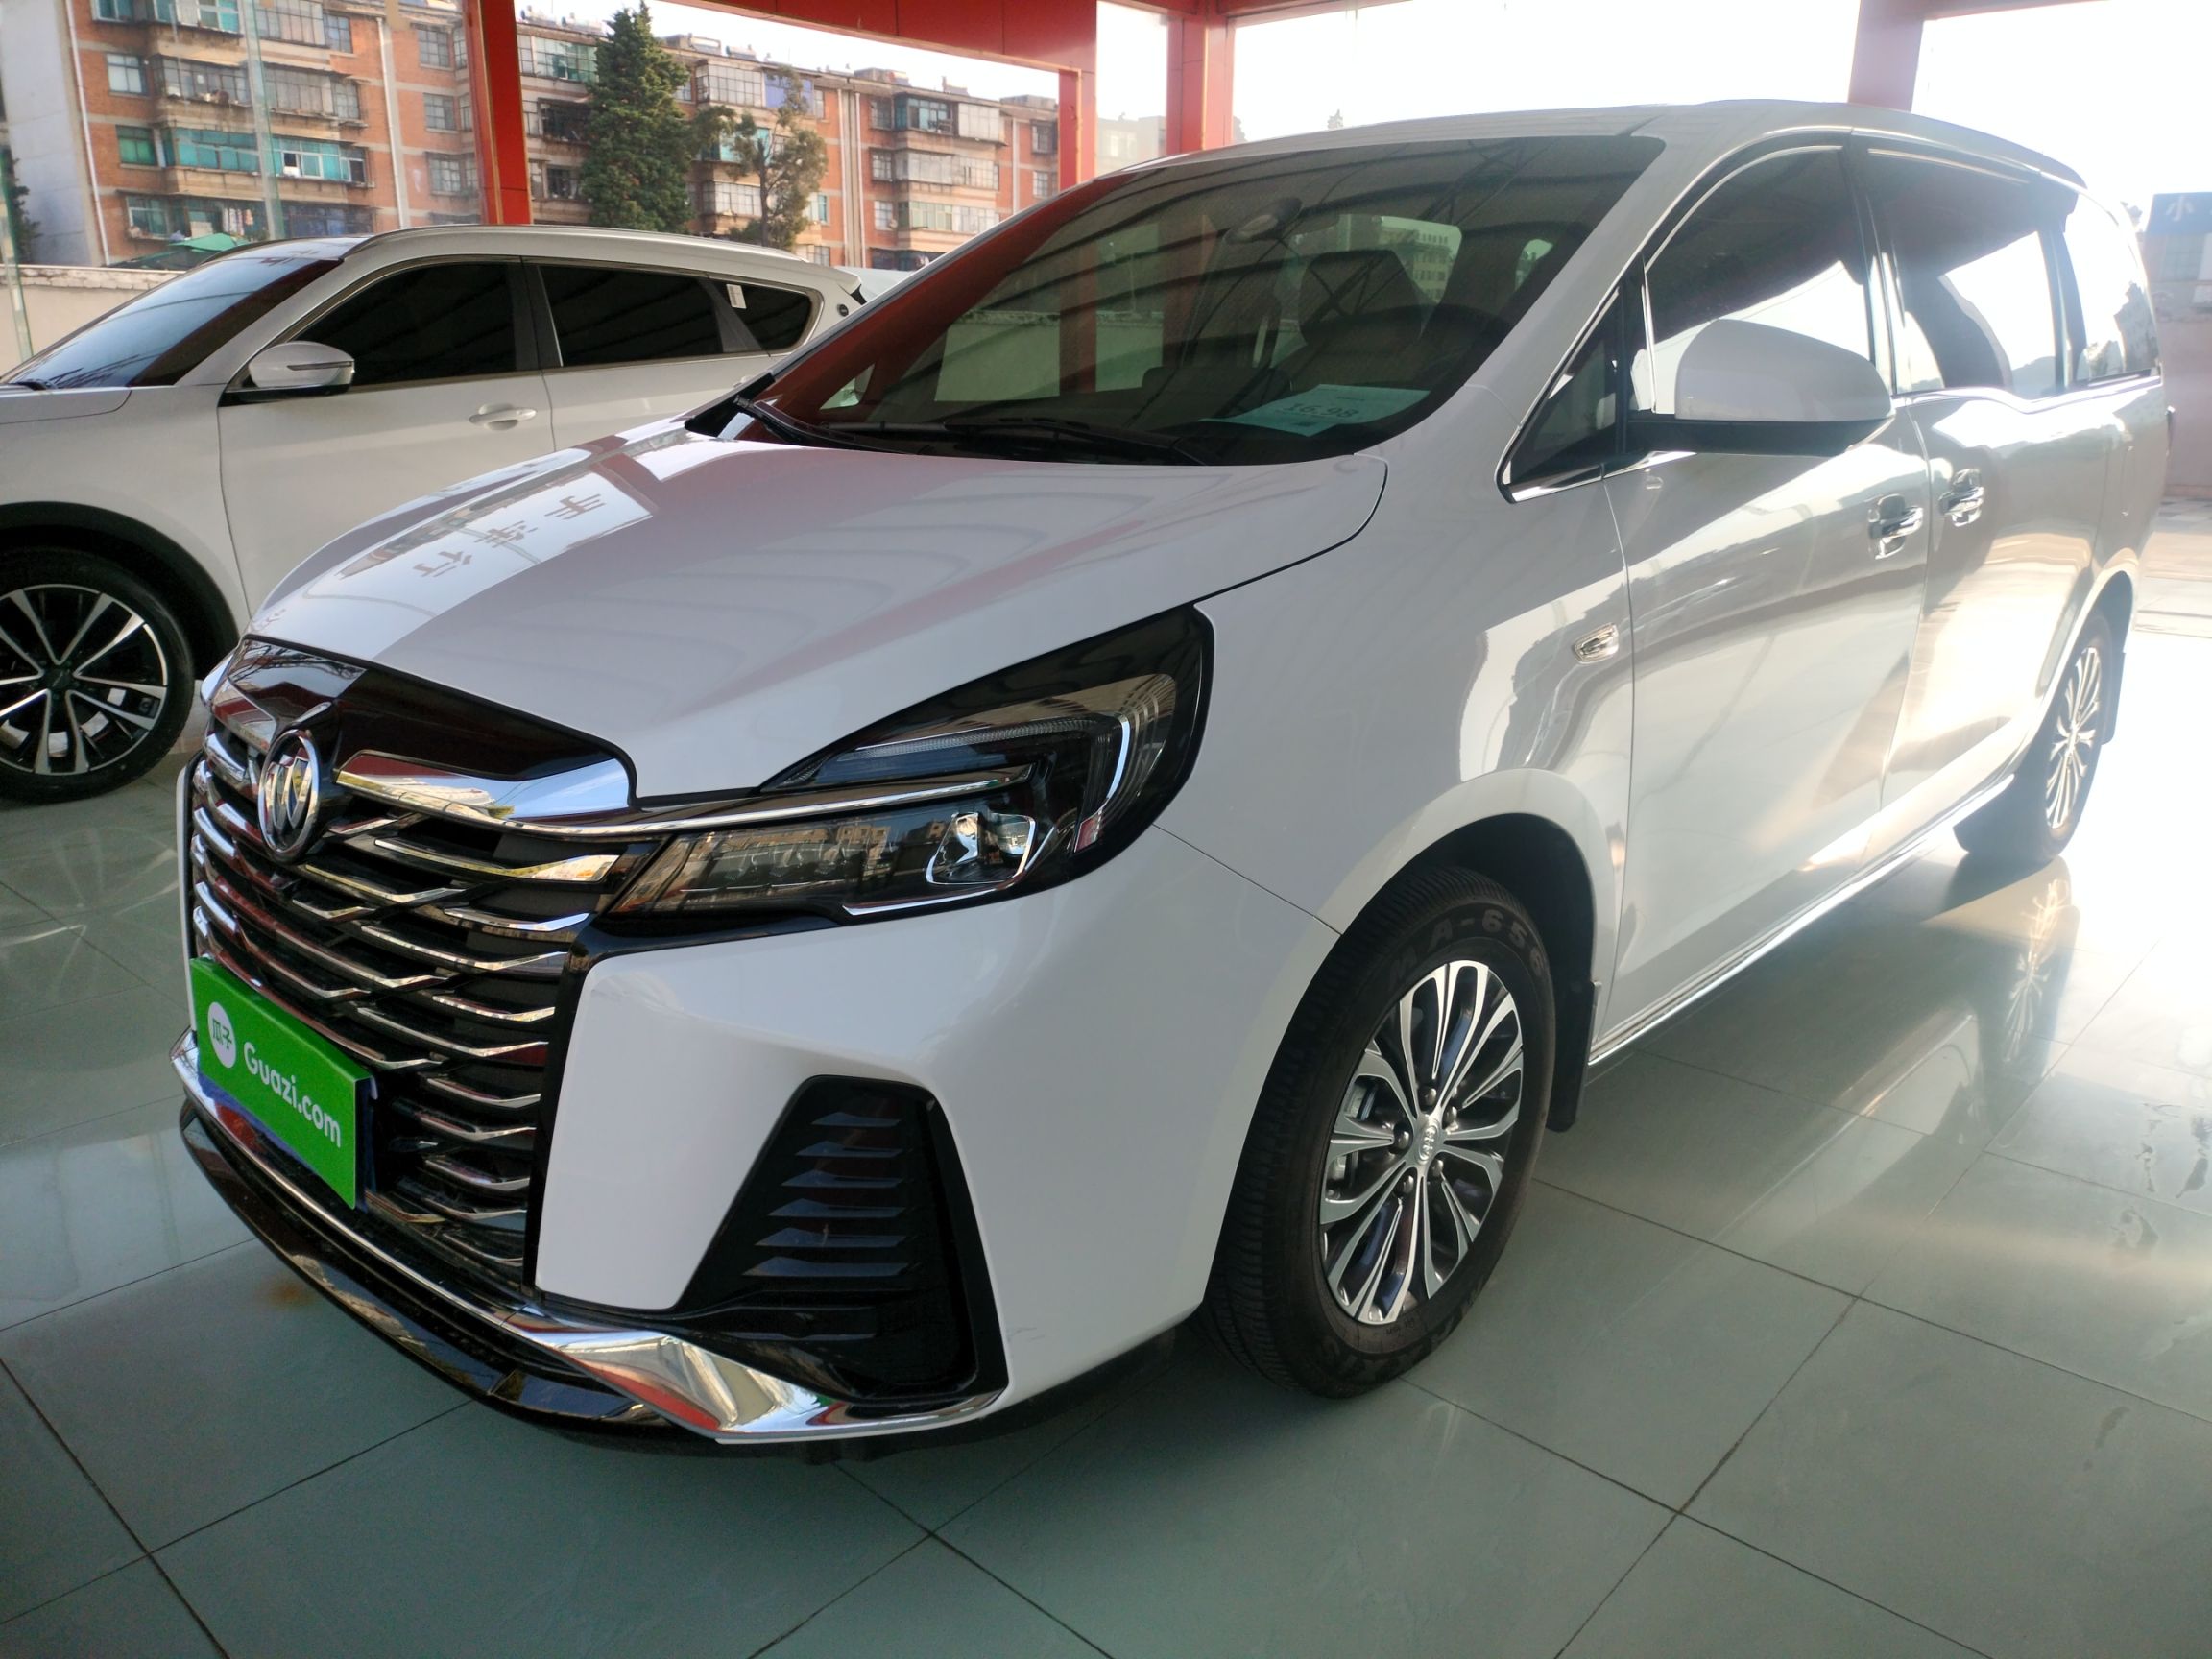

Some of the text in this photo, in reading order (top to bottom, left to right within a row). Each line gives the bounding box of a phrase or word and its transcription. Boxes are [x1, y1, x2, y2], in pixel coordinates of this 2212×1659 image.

[2165, 194, 2212, 222] 小
[212, 1018, 233, 1050] 瓜子
[243, 1041, 342, 1148] Guazi.com
